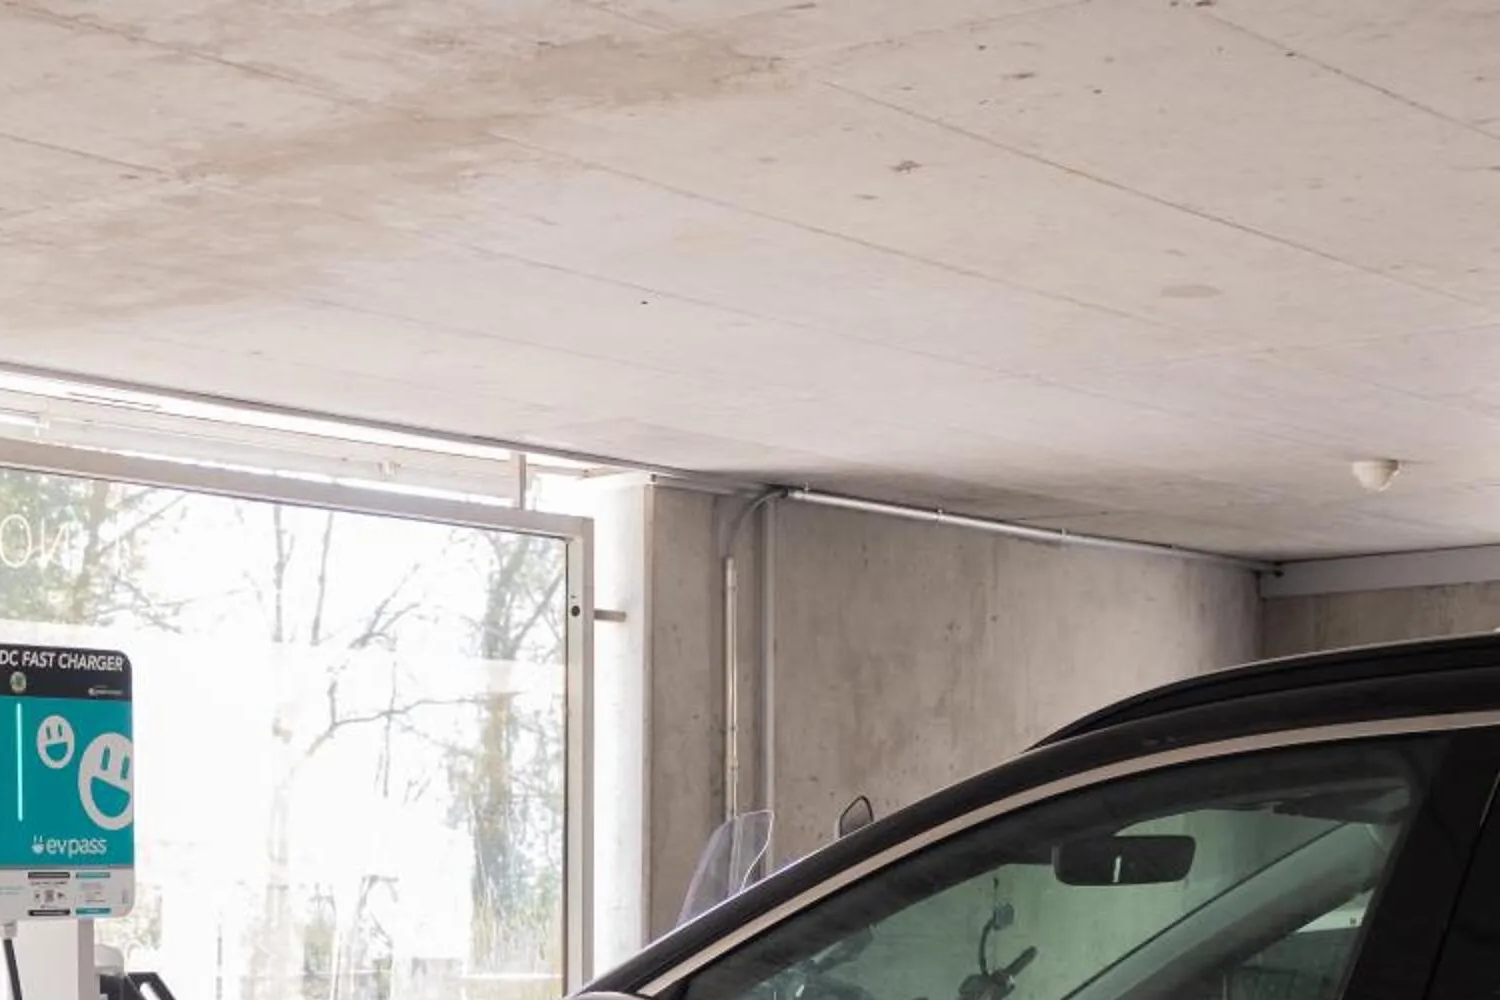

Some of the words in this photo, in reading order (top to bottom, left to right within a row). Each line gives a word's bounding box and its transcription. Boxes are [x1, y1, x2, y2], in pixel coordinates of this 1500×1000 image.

[22, 650, 54, 669] FAST
[58, 652, 123, 672] CHARGER
[46, 836, 108, 858] evpass
